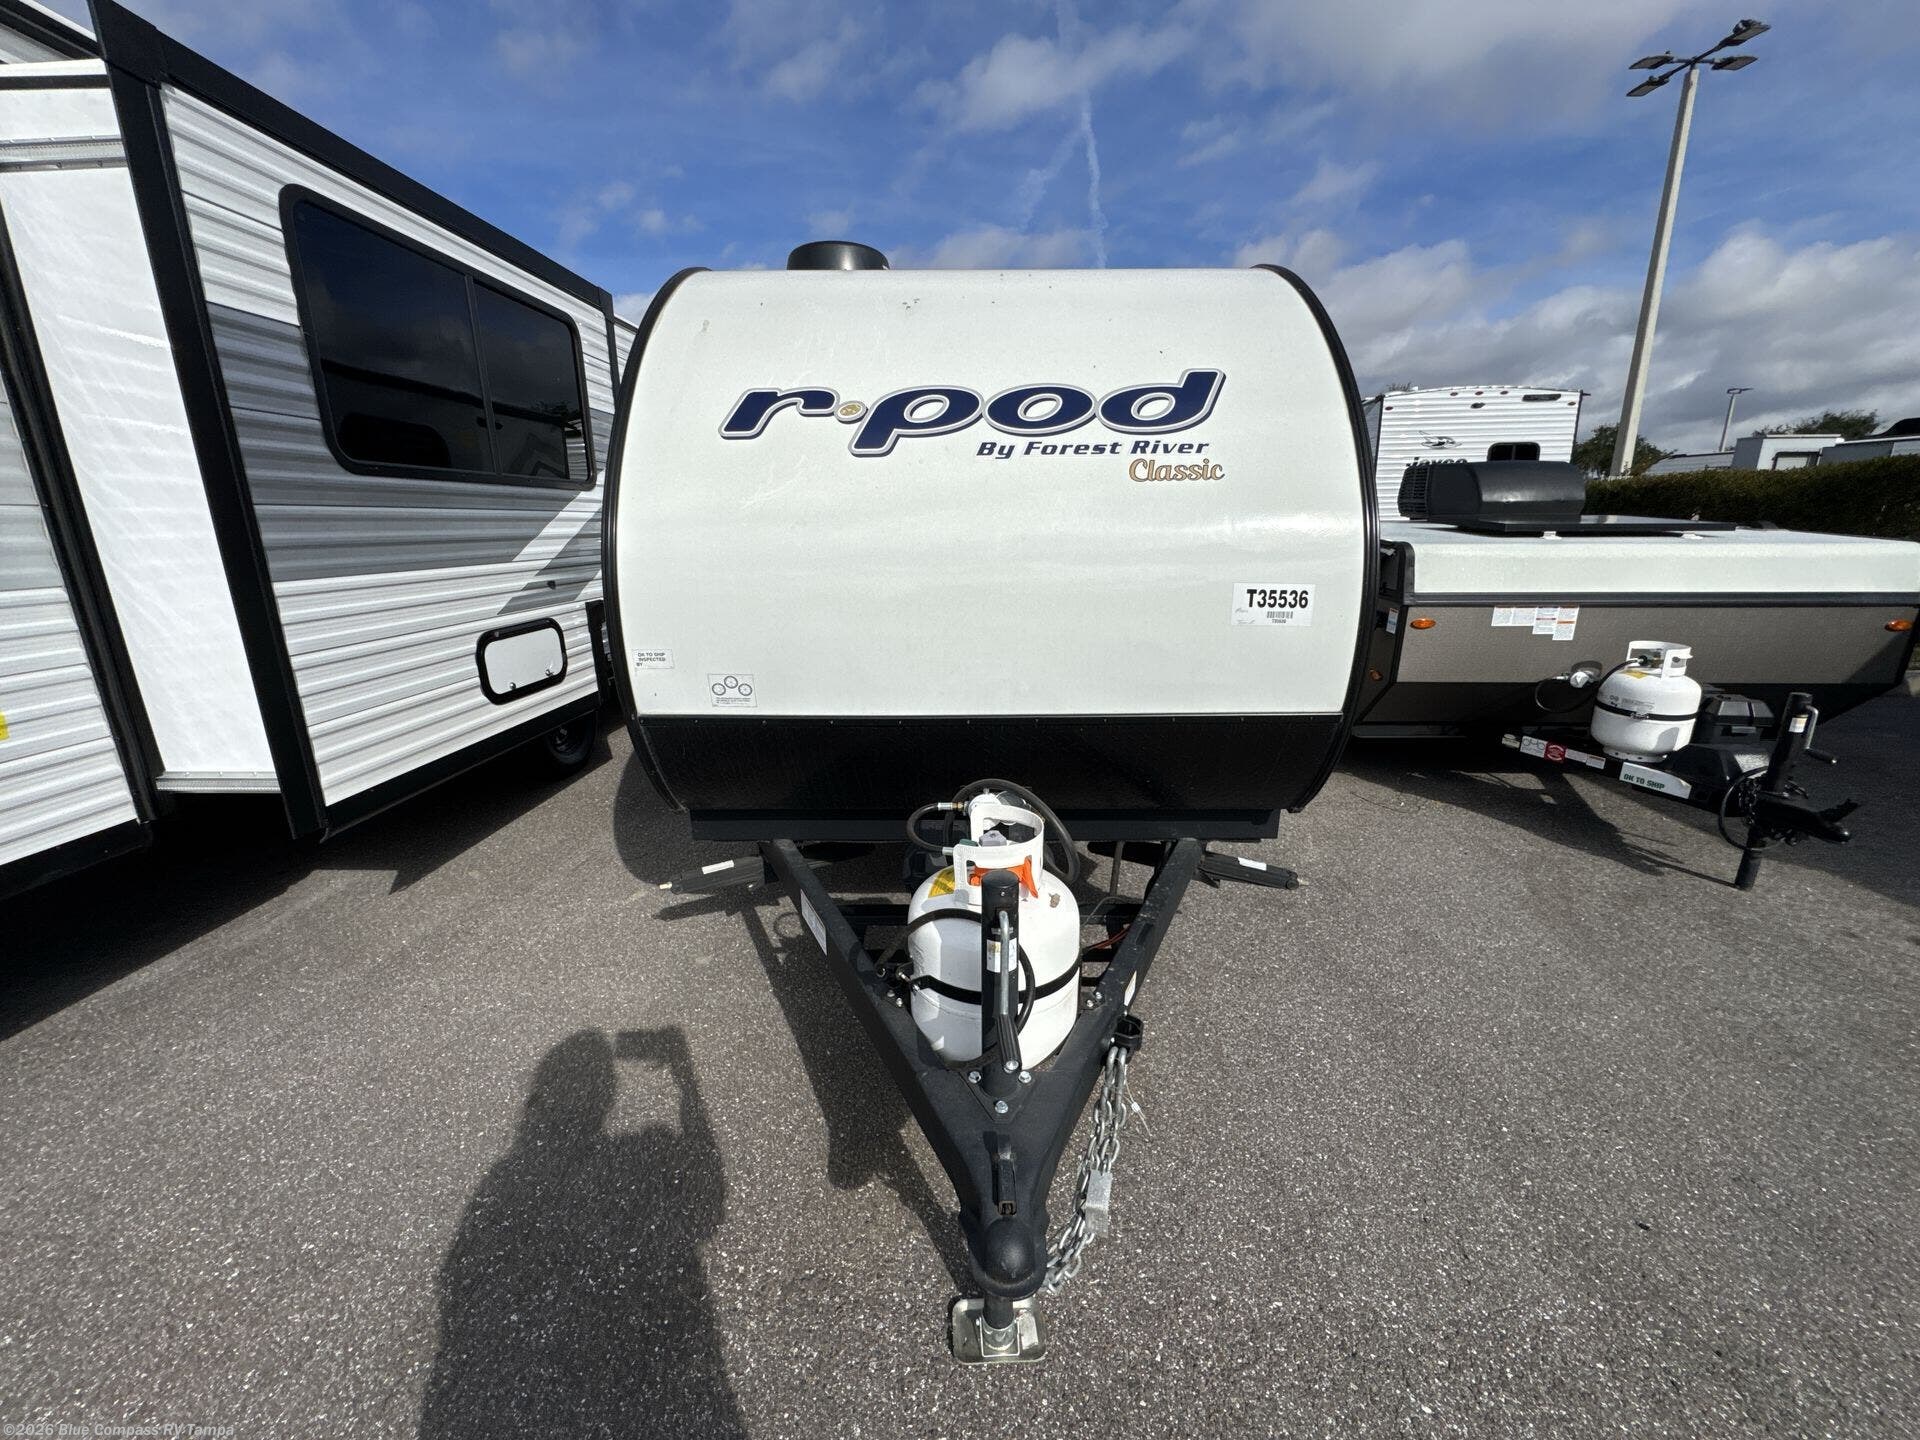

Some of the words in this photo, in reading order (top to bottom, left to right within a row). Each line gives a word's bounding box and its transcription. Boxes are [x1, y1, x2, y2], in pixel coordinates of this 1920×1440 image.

[976, 441, 1015, 459] By
[1023, 441, 1122, 455] Forest
[1130, 440, 1210, 455] River
[1128, 458, 1226, 482] Classic
[1246, 588, 1309, 609] T35536
[1624, 774, 1634, 782] OK
[1646, 780, 1664, 789] SHIP
